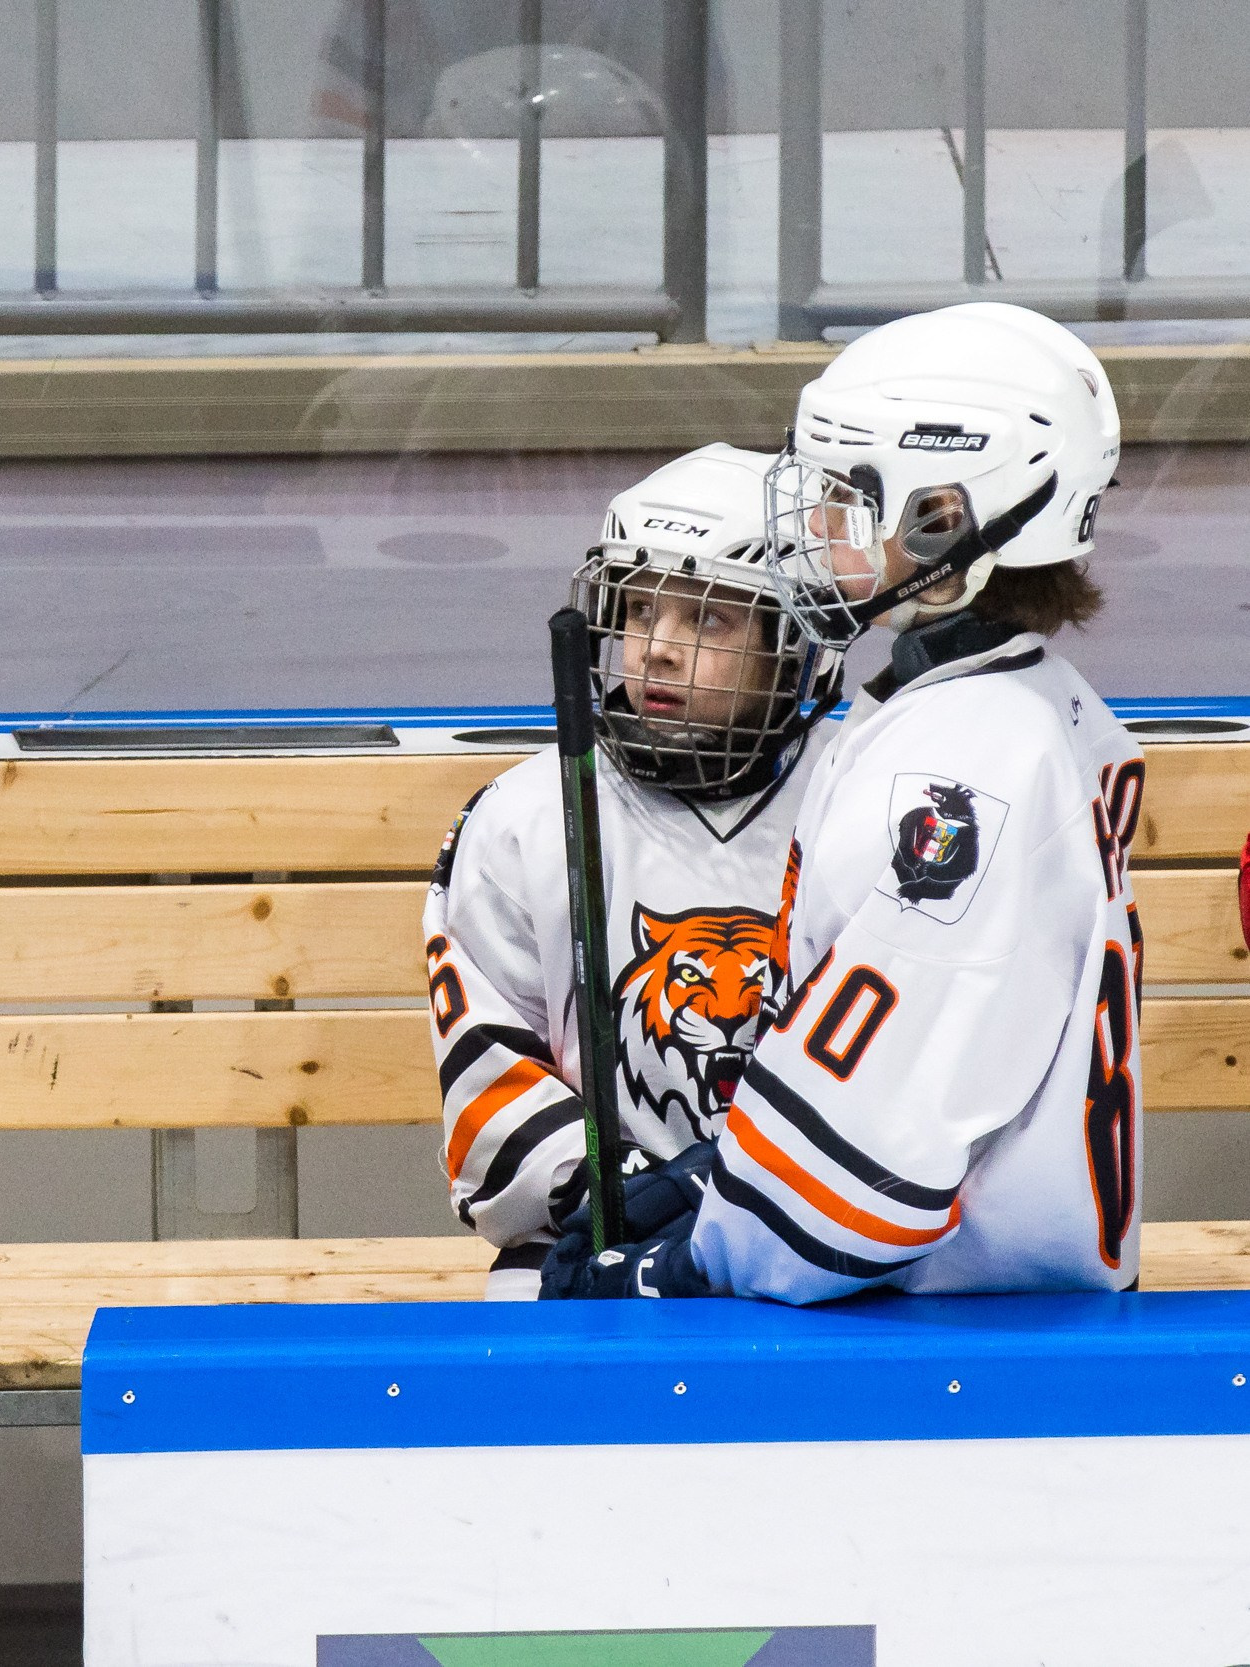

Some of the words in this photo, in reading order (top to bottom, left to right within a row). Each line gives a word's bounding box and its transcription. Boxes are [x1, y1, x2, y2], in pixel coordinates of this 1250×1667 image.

[902, 433, 983, 448] BAUER
[643, 518, 710, 538] CCM
[896, 563, 953, 598] BAUER
